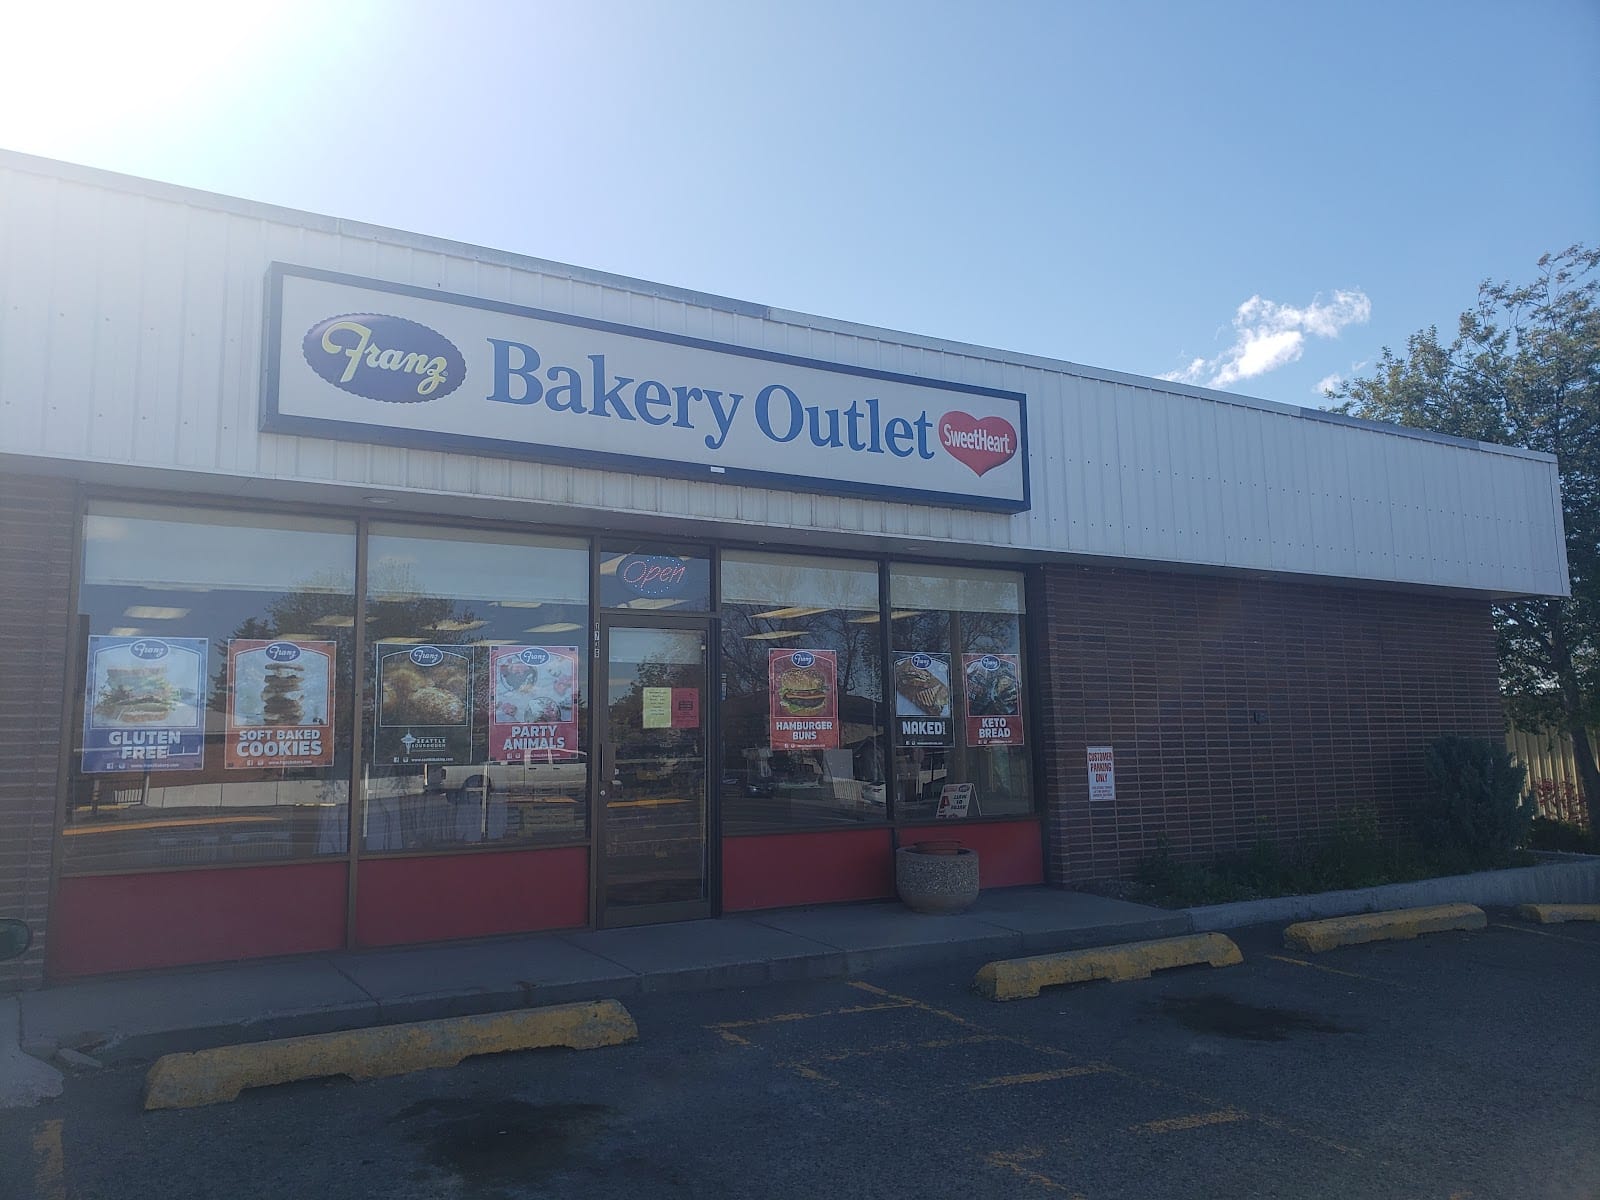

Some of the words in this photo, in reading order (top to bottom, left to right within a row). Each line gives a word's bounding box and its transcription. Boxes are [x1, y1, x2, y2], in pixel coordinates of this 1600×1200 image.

[322, 321, 448, 394] Franz
[486, 338, 743, 450] Bakery
[754, 384, 935, 460] Outlet
[623, 560, 686, 589] Open
[134, 643, 164, 658] Franz
[268, 646, 297, 660] Franz
[414, 649, 438, 663] Franz
[523, 651, 546, 663] Franz
[775, 721, 833, 731] HAMBURGER
[902, 721, 942, 735] NAKED
[982, 718, 1007, 728] KETO
[108, 731, 181, 745] GLUTEN
[239, 730, 272, 740] SOFT
[276, 729, 321, 740] BAKED
[511, 725, 557, 738] PARTY
[792, 731, 817, 740] BUNS
[978, 728, 1011, 739] BREAD
[236, 740, 323, 757] COOKIES
[503, 737, 565, 751] ANIMALS
[121, 745, 169, 760] FREE
